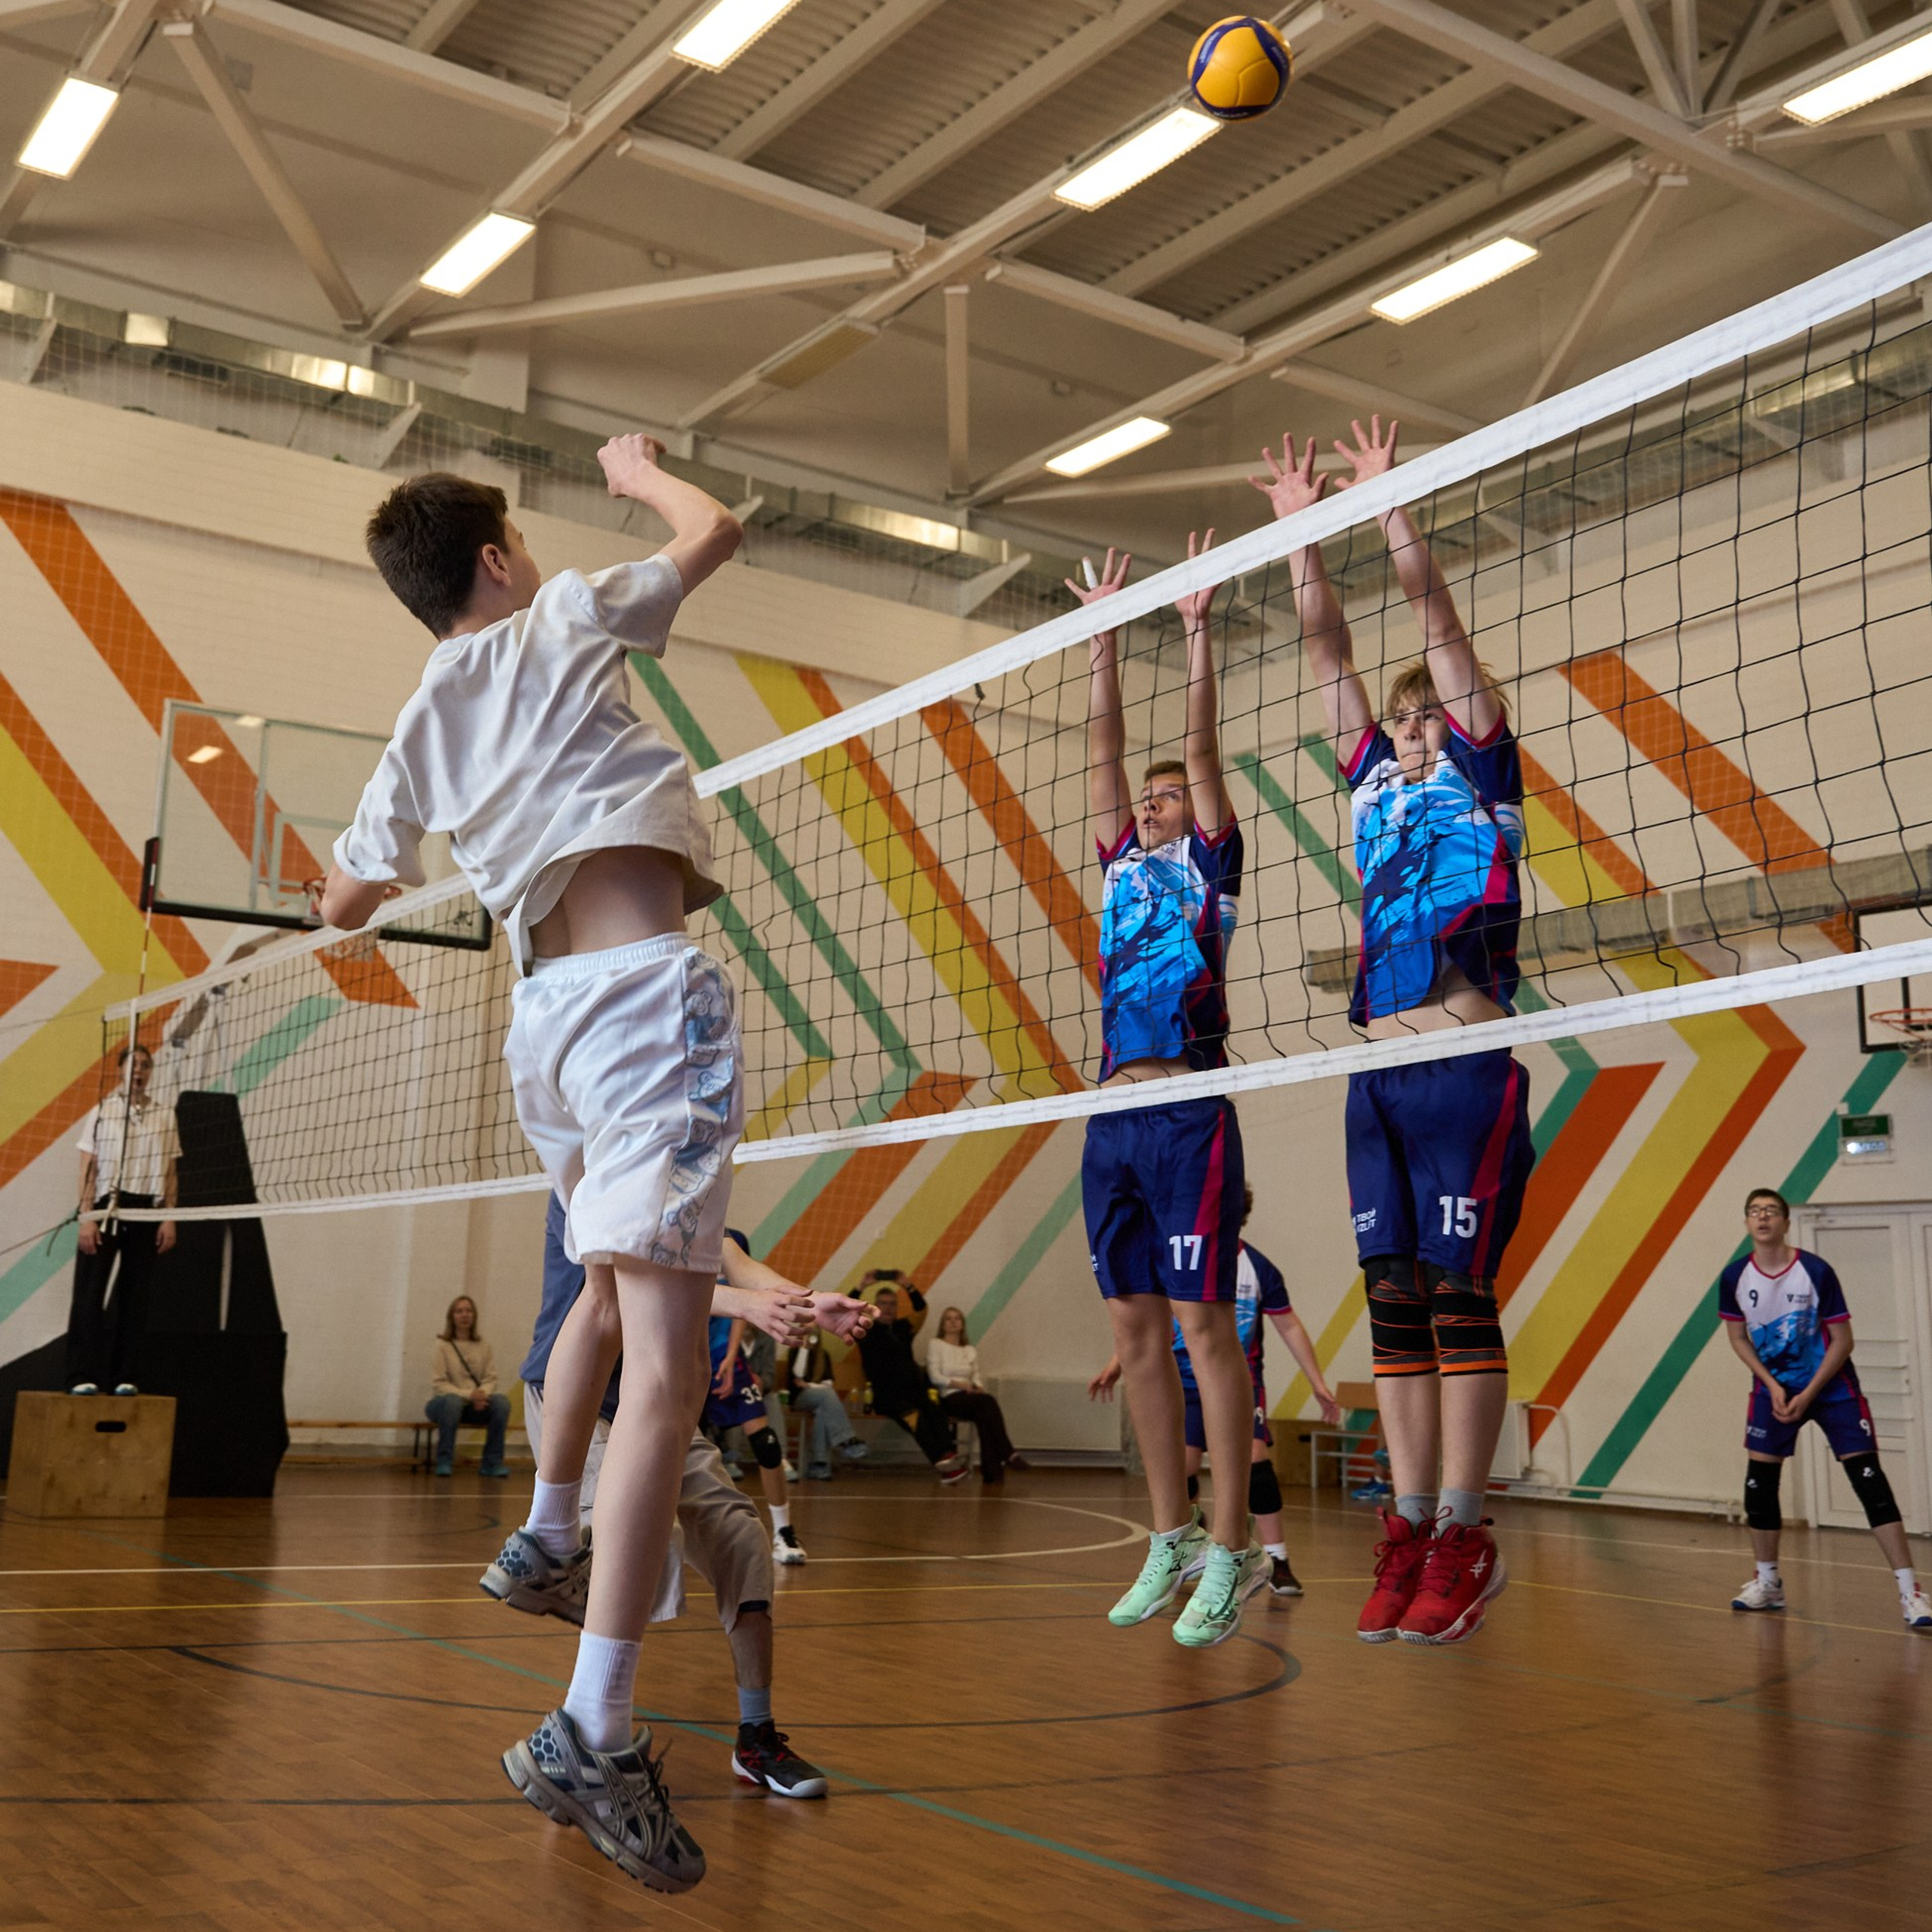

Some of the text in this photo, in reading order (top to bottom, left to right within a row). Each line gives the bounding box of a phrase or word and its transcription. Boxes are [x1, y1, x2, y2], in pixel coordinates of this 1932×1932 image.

[1439, 1195, 1477, 1238] 15
[1169, 1235, 1203, 1271] 17
[1749, 1289, 1758, 1308] 9
[741, 1383, 762, 1404] 33
[1859, 1419, 1872, 1436] 9
